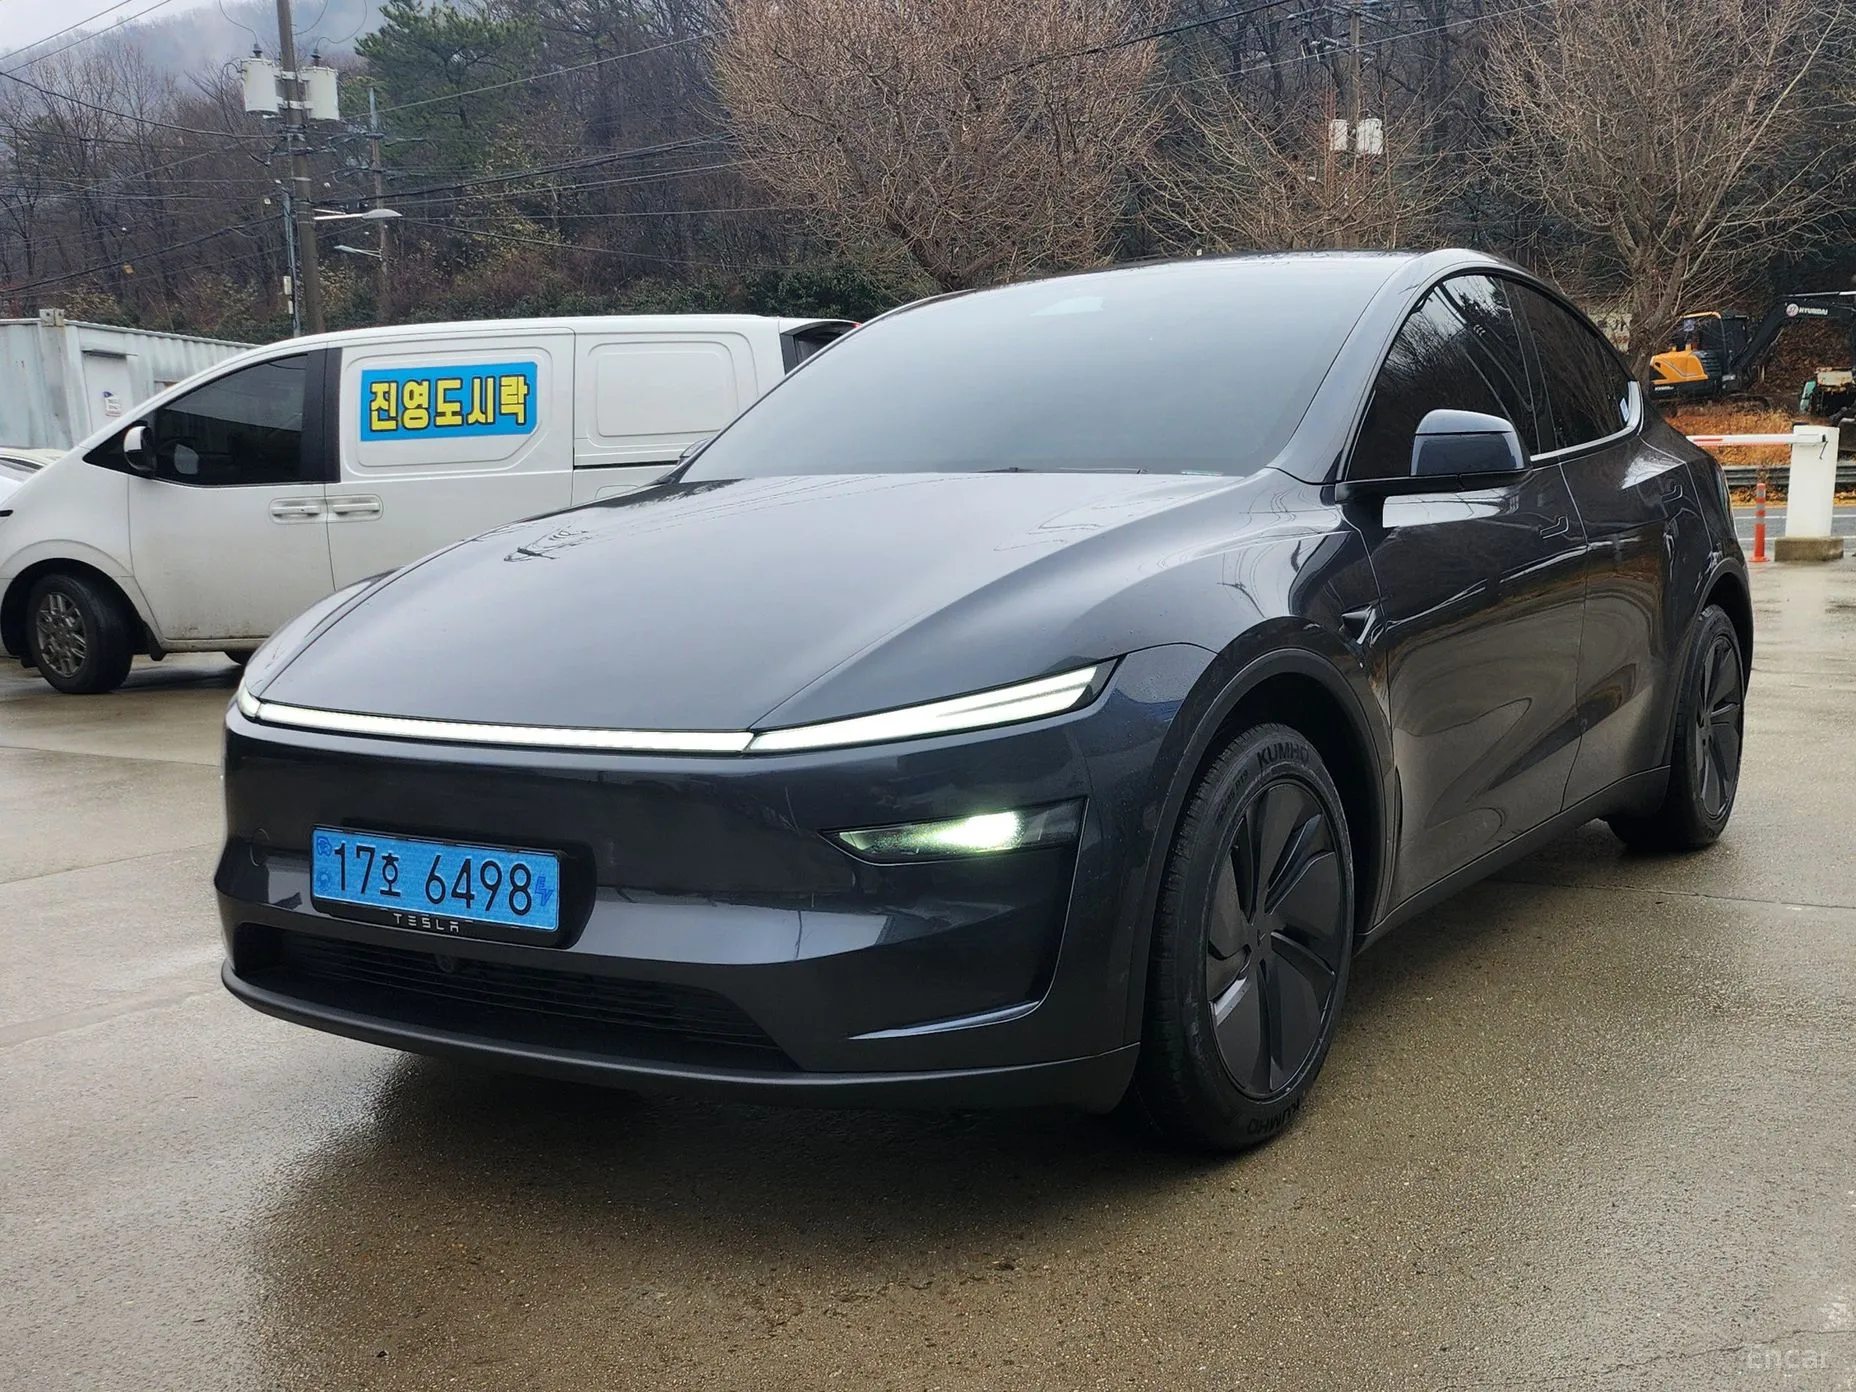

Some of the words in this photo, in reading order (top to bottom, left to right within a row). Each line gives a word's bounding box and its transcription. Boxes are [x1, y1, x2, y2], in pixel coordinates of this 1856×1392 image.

[1798, 306, 1828, 316] HYUNDAI
[369, 373, 529, 432] 진영도시락
[1256, 741, 1310, 766] KUMHO
[334, 842, 401, 897] 17호
[425, 854, 532, 916] 6498
[393, 912, 459, 933] TESLA
